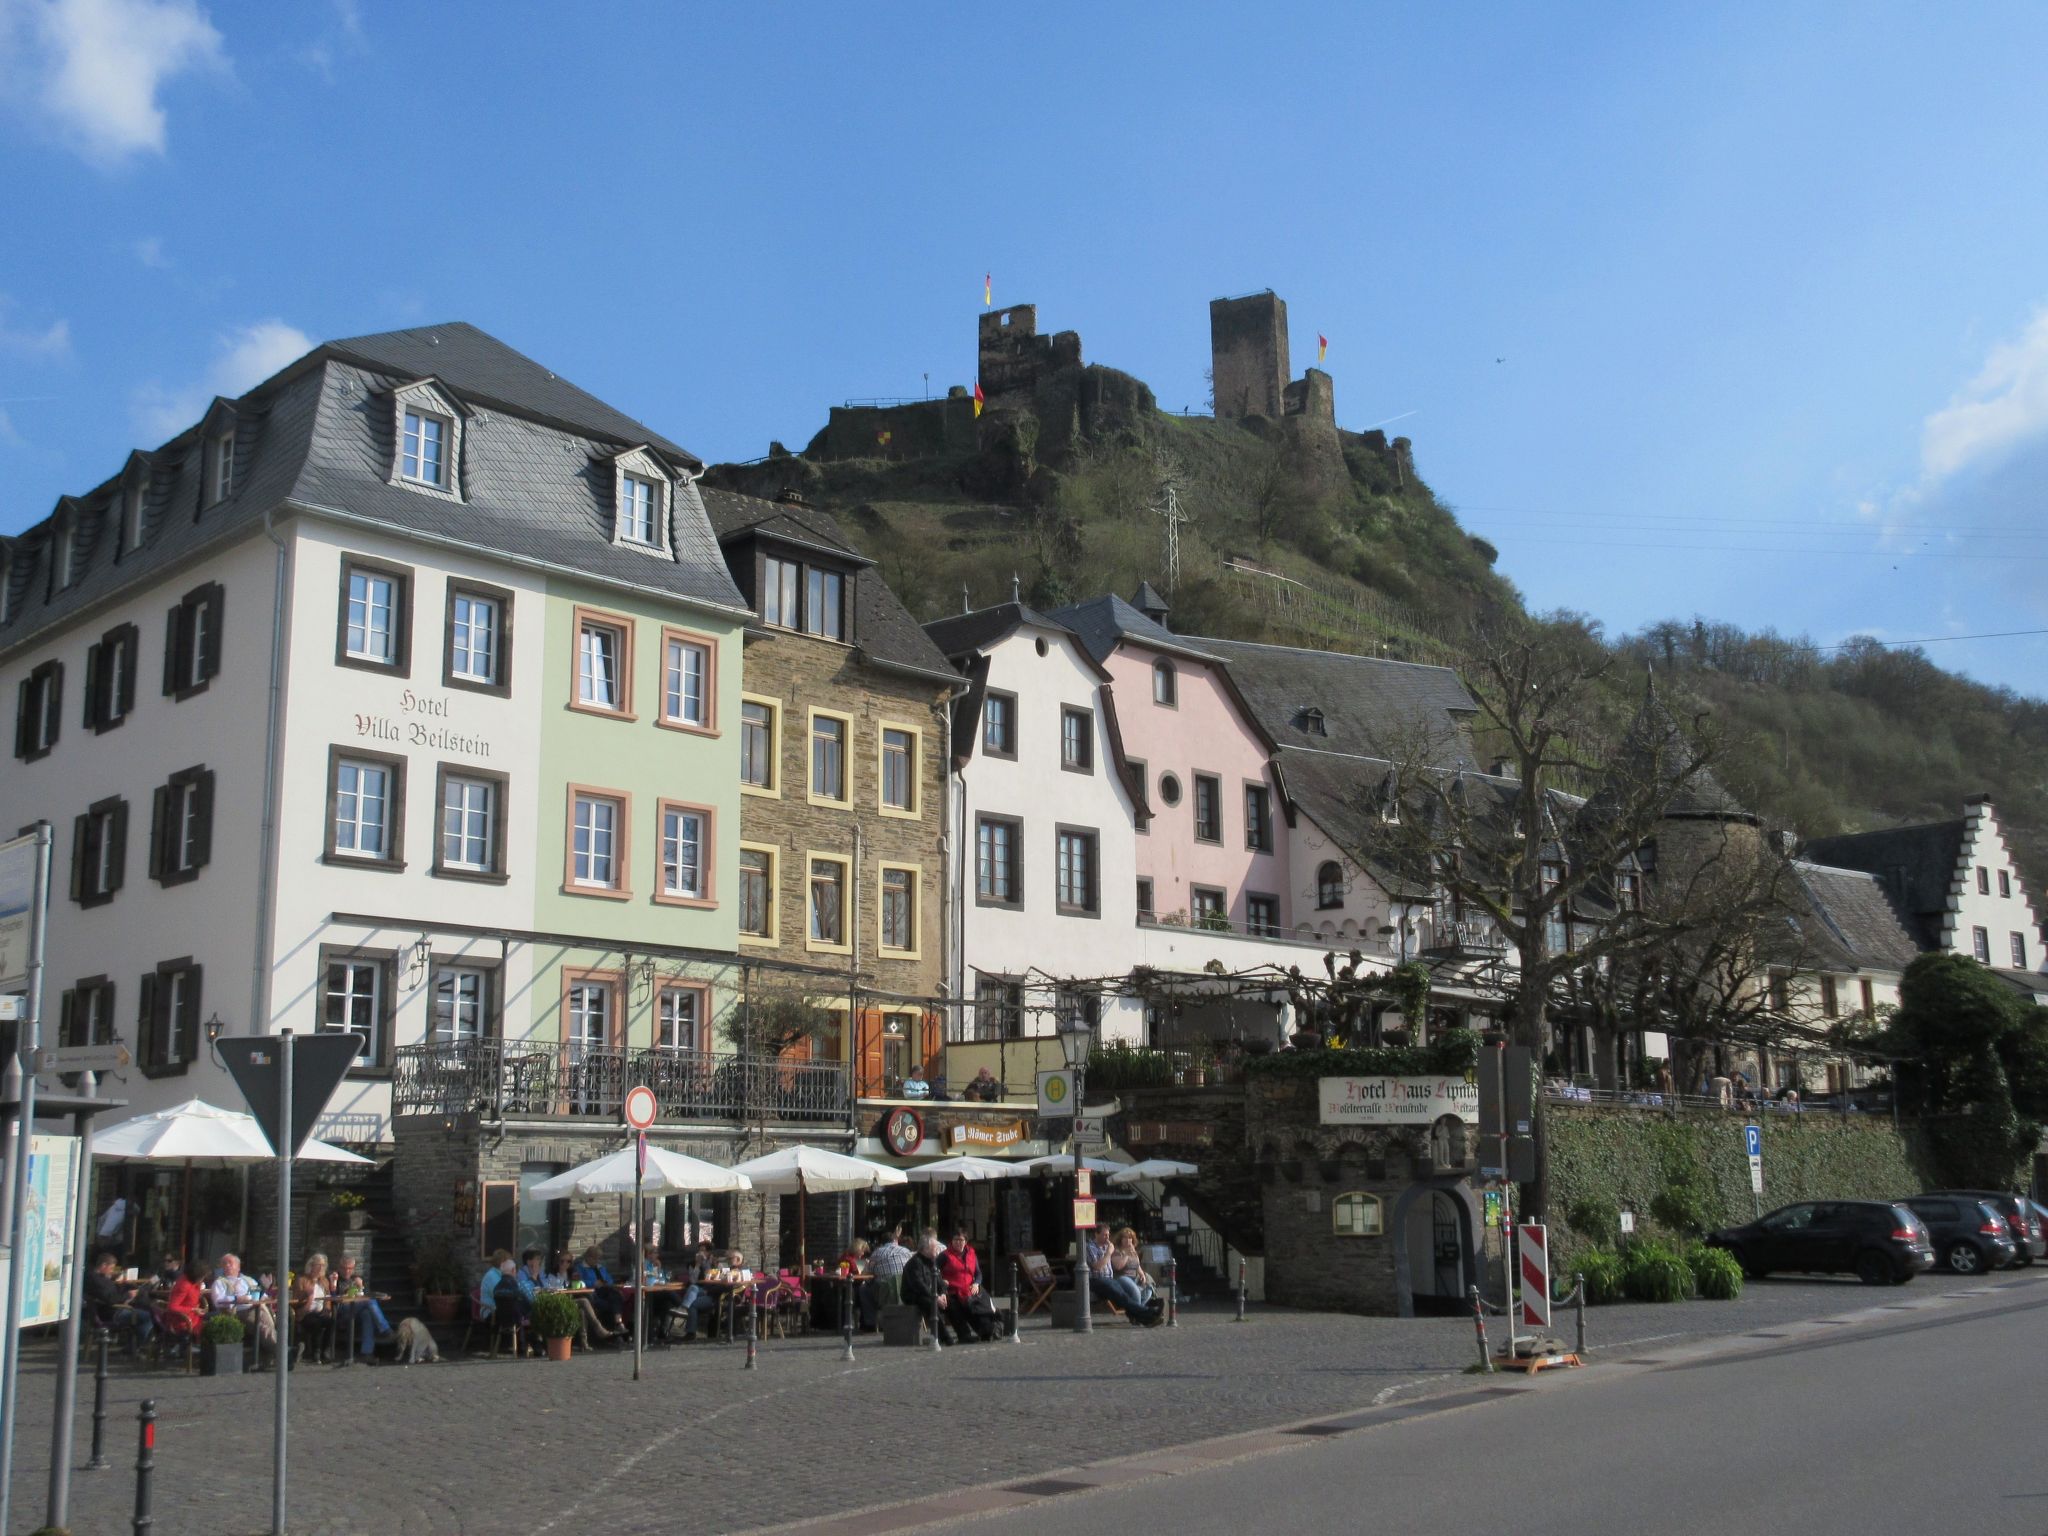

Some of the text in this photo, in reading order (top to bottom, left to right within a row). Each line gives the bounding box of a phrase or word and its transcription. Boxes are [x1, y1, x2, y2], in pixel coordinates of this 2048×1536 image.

[400, 689, 448, 717] Hotel
[355, 714, 490, 757] Villa Beilstein
[1051, 1082, 1060, 1097] H
[1346, 1080, 1386, 1101] Hotel
[1391, 1079, 1431, 1101] Haus
[967, 1127, 1018, 1143] Römer Stube
[1749, 1130, 1757, 1153] P
